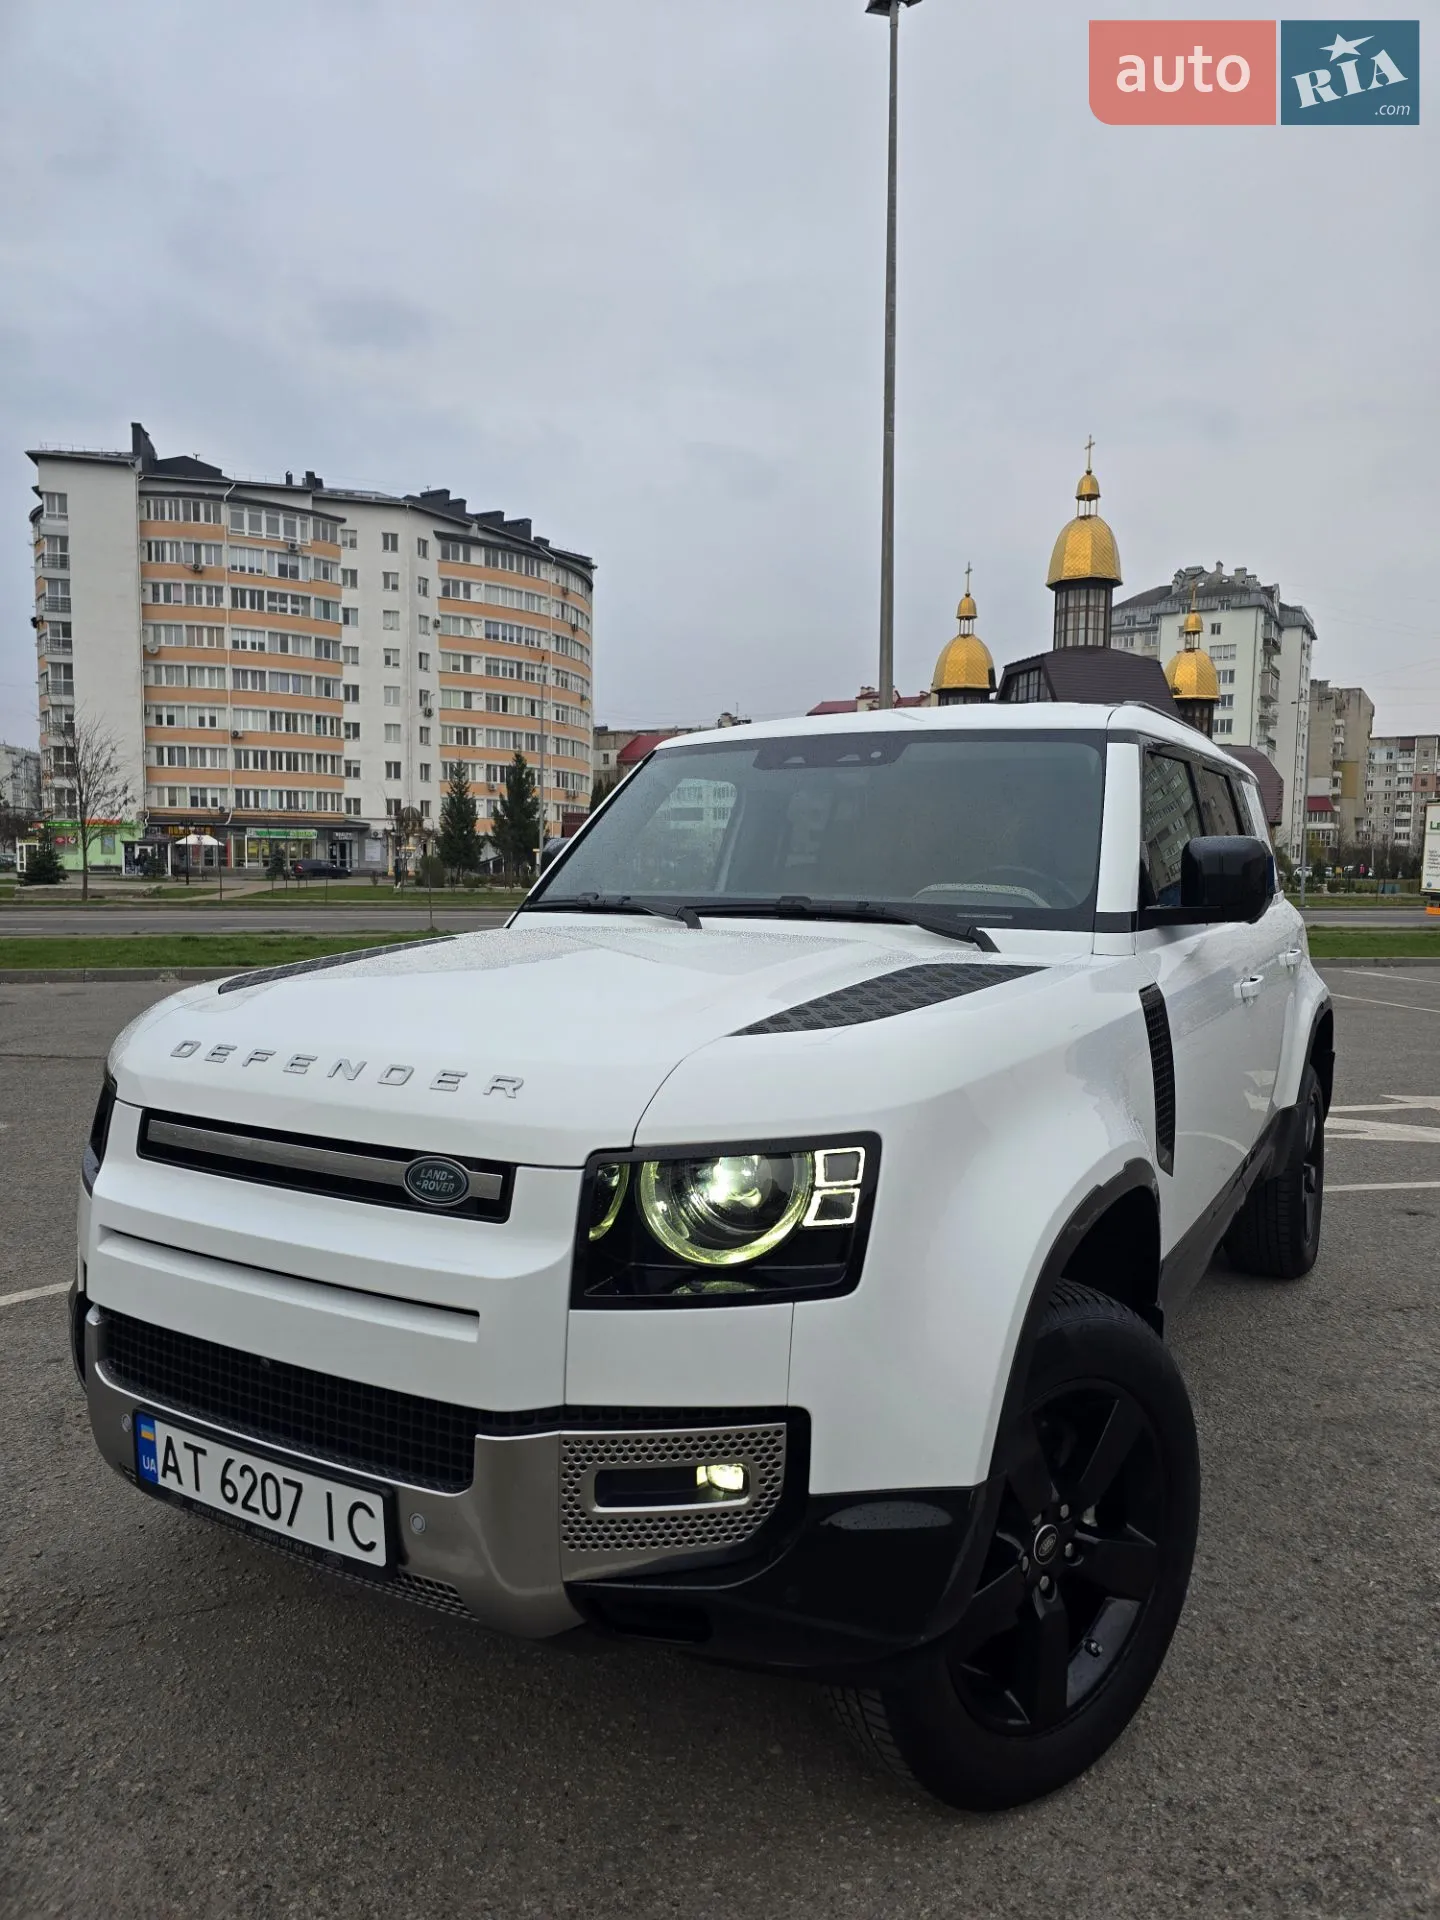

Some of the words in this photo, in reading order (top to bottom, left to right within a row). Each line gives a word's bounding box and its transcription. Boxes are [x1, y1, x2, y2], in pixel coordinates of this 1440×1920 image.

[170, 1040, 525, 1099] DEFENDER
[420, 1168, 448, 1181] LAND
[420, 1180, 455, 1193] ROVER
[142, 1455, 157, 1473] UA
[161, 1435, 207, 1492] AT
[220, 1457, 304, 1527] 6207
[326, 1491, 377, 1553] IC
